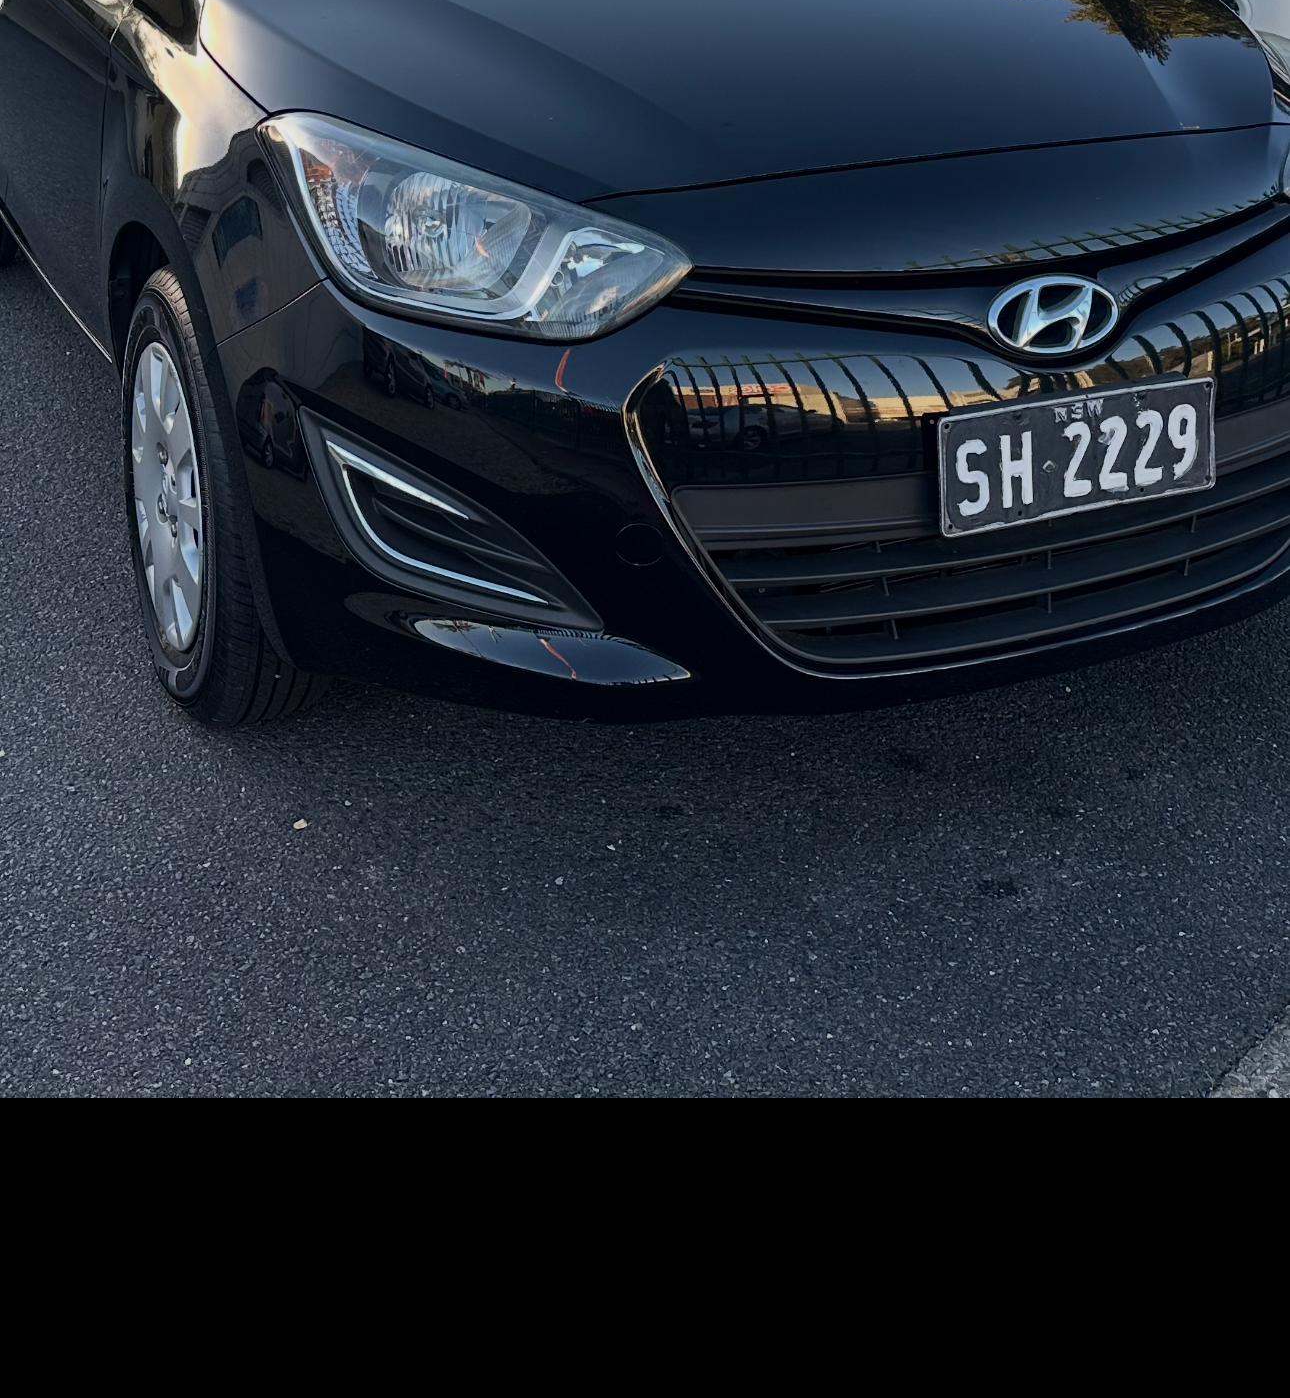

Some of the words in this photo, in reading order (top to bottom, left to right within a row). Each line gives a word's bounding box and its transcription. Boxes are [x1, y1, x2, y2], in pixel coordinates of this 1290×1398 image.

[1053, 398, 1104, 423] NSW
[955, 430, 1034, 517] SH
[1061, 403, 1199, 499] 2229
